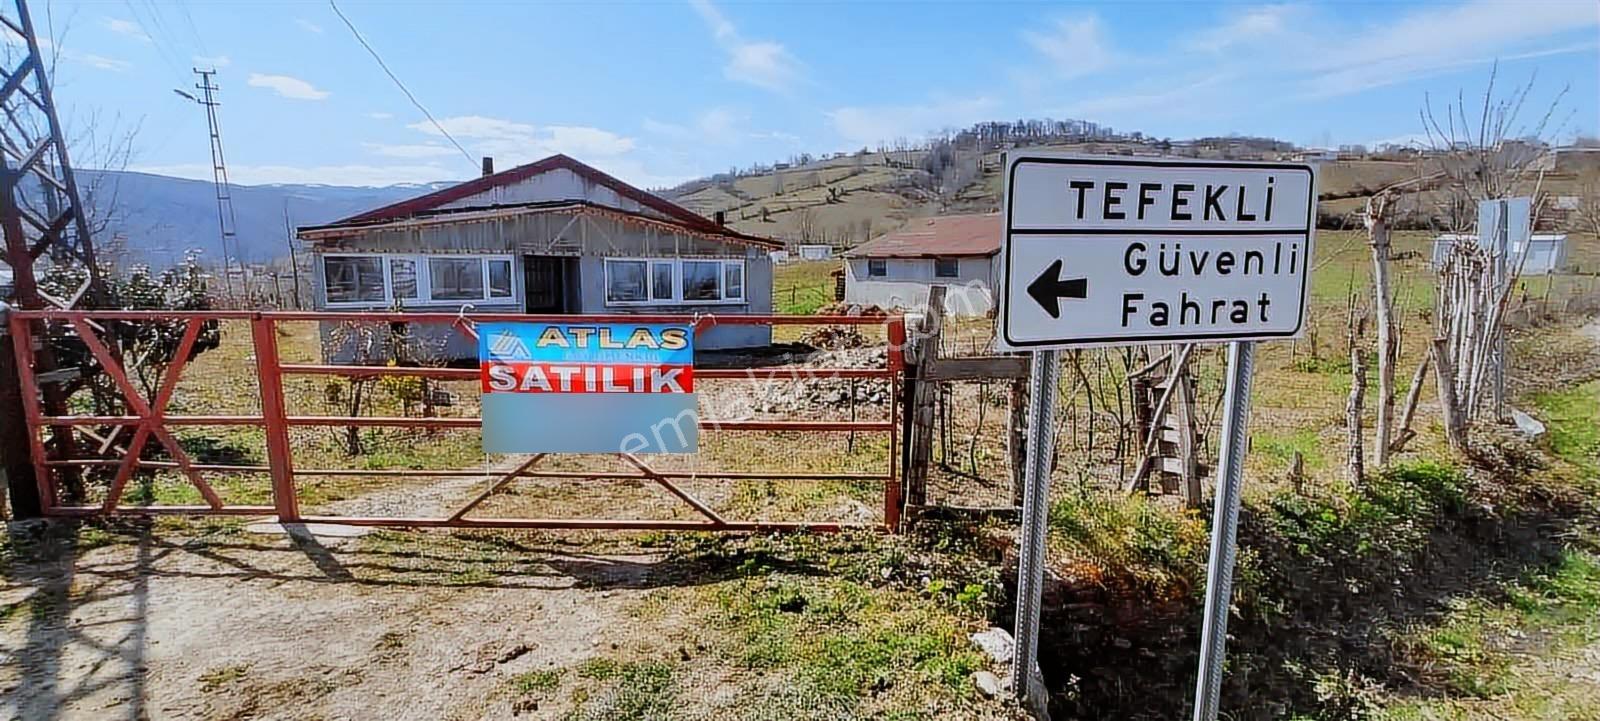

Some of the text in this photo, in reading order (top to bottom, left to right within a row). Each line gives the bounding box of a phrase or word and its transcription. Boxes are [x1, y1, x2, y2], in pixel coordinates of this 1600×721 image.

[1069, 176, 1275, 222] TEFEKLİ
[1123, 242, 1299, 277] Güvenli
[1121, 292, 1271, 327] Fahrat
[536, 326, 689, 350] ATLAS
[488, 364, 686, 393] SATILIK
